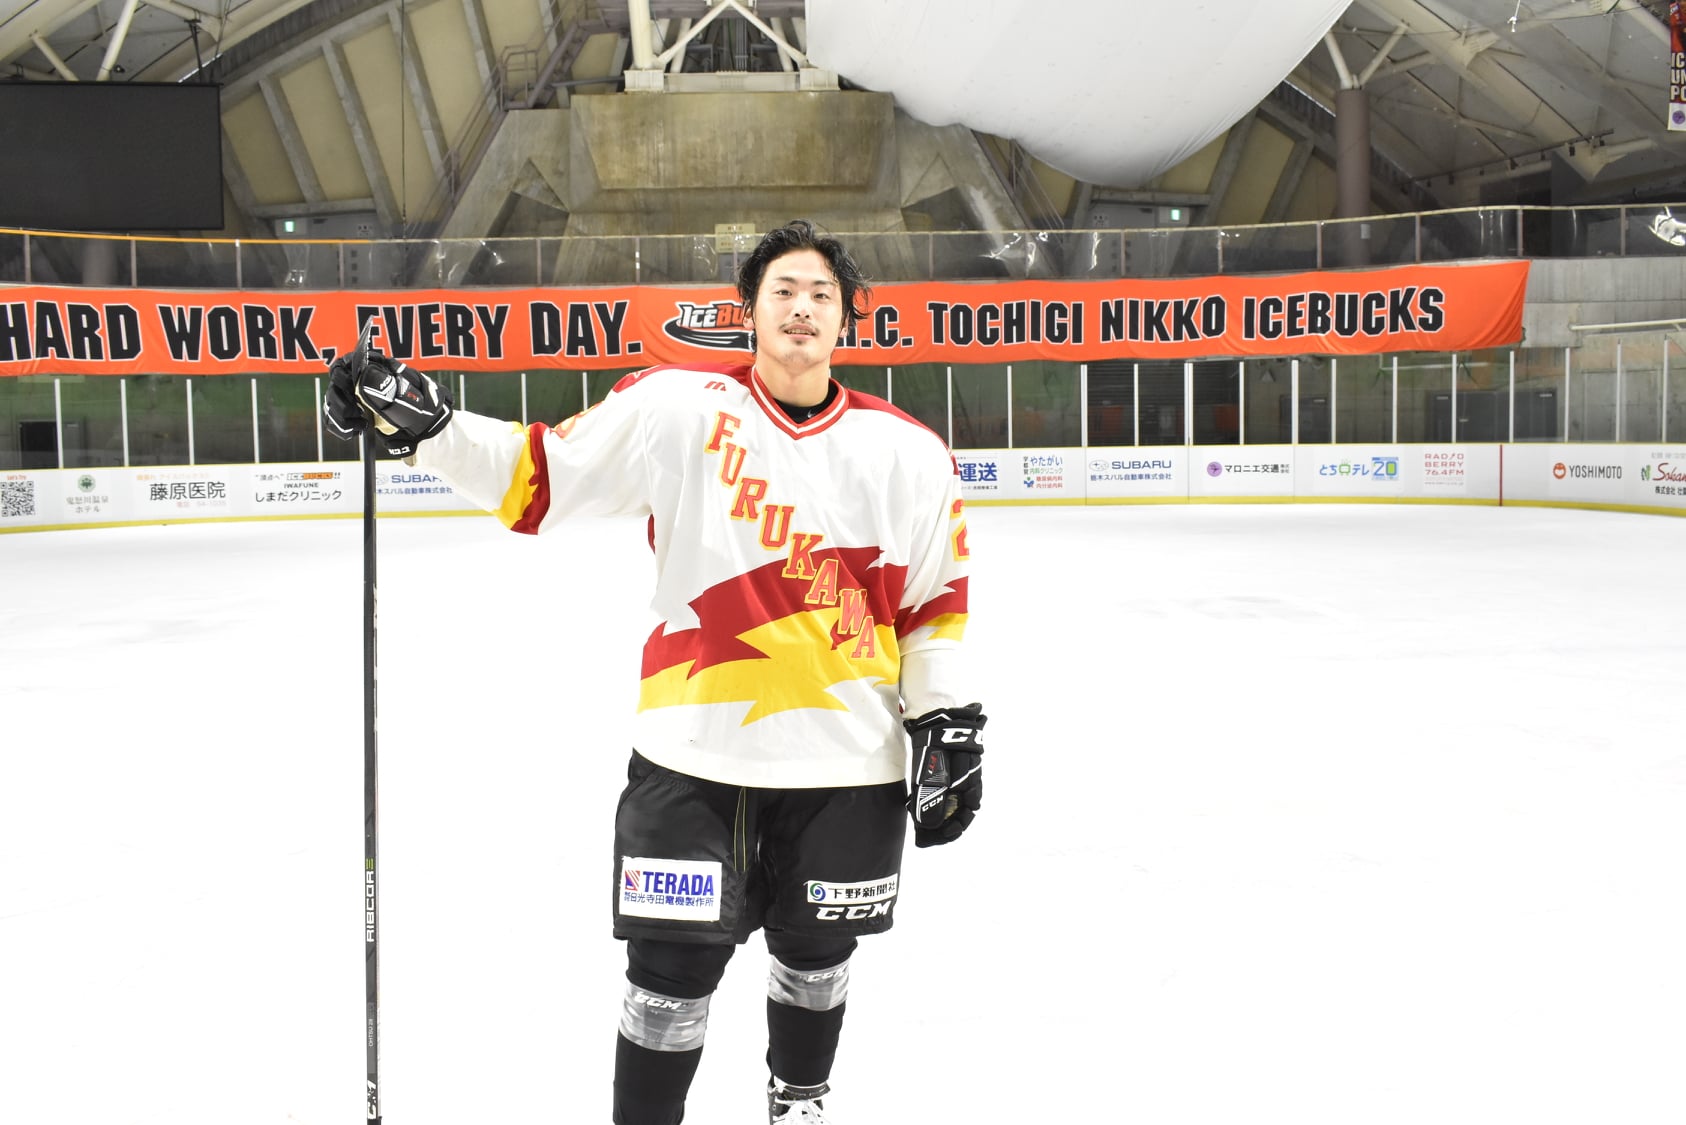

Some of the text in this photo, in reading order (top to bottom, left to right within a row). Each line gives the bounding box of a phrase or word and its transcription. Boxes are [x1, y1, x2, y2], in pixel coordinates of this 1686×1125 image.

[926, 300, 1085, 347] TOCHIGI
[1100, 295, 1227, 343] NIKKO
[1243, 286, 1445, 341] ICEBUCKS
[0, 300, 643, 367] HARD WORK, EVERY DAY.
[1030, 455, 1063, 467] やたがい
[1111, 459, 1172, 470] SUBARU
[1224, 464, 1279, 473] マロニエ交通
[958, 462, 998, 481] 運送
[1569, 465, 1623, 479] YOSHIMOTO
[149, 481, 226, 501] 藤原医院
[255, 489, 342, 502] しまだクリニック
[704, 410, 876, 659] FURUKAWA
[643, 871, 714, 896] TERADA
[828, 880, 896, 899] 下野新聞社
[366, 870, 375, 942] RIBCOR
[816, 900, 892, 920] CCM
